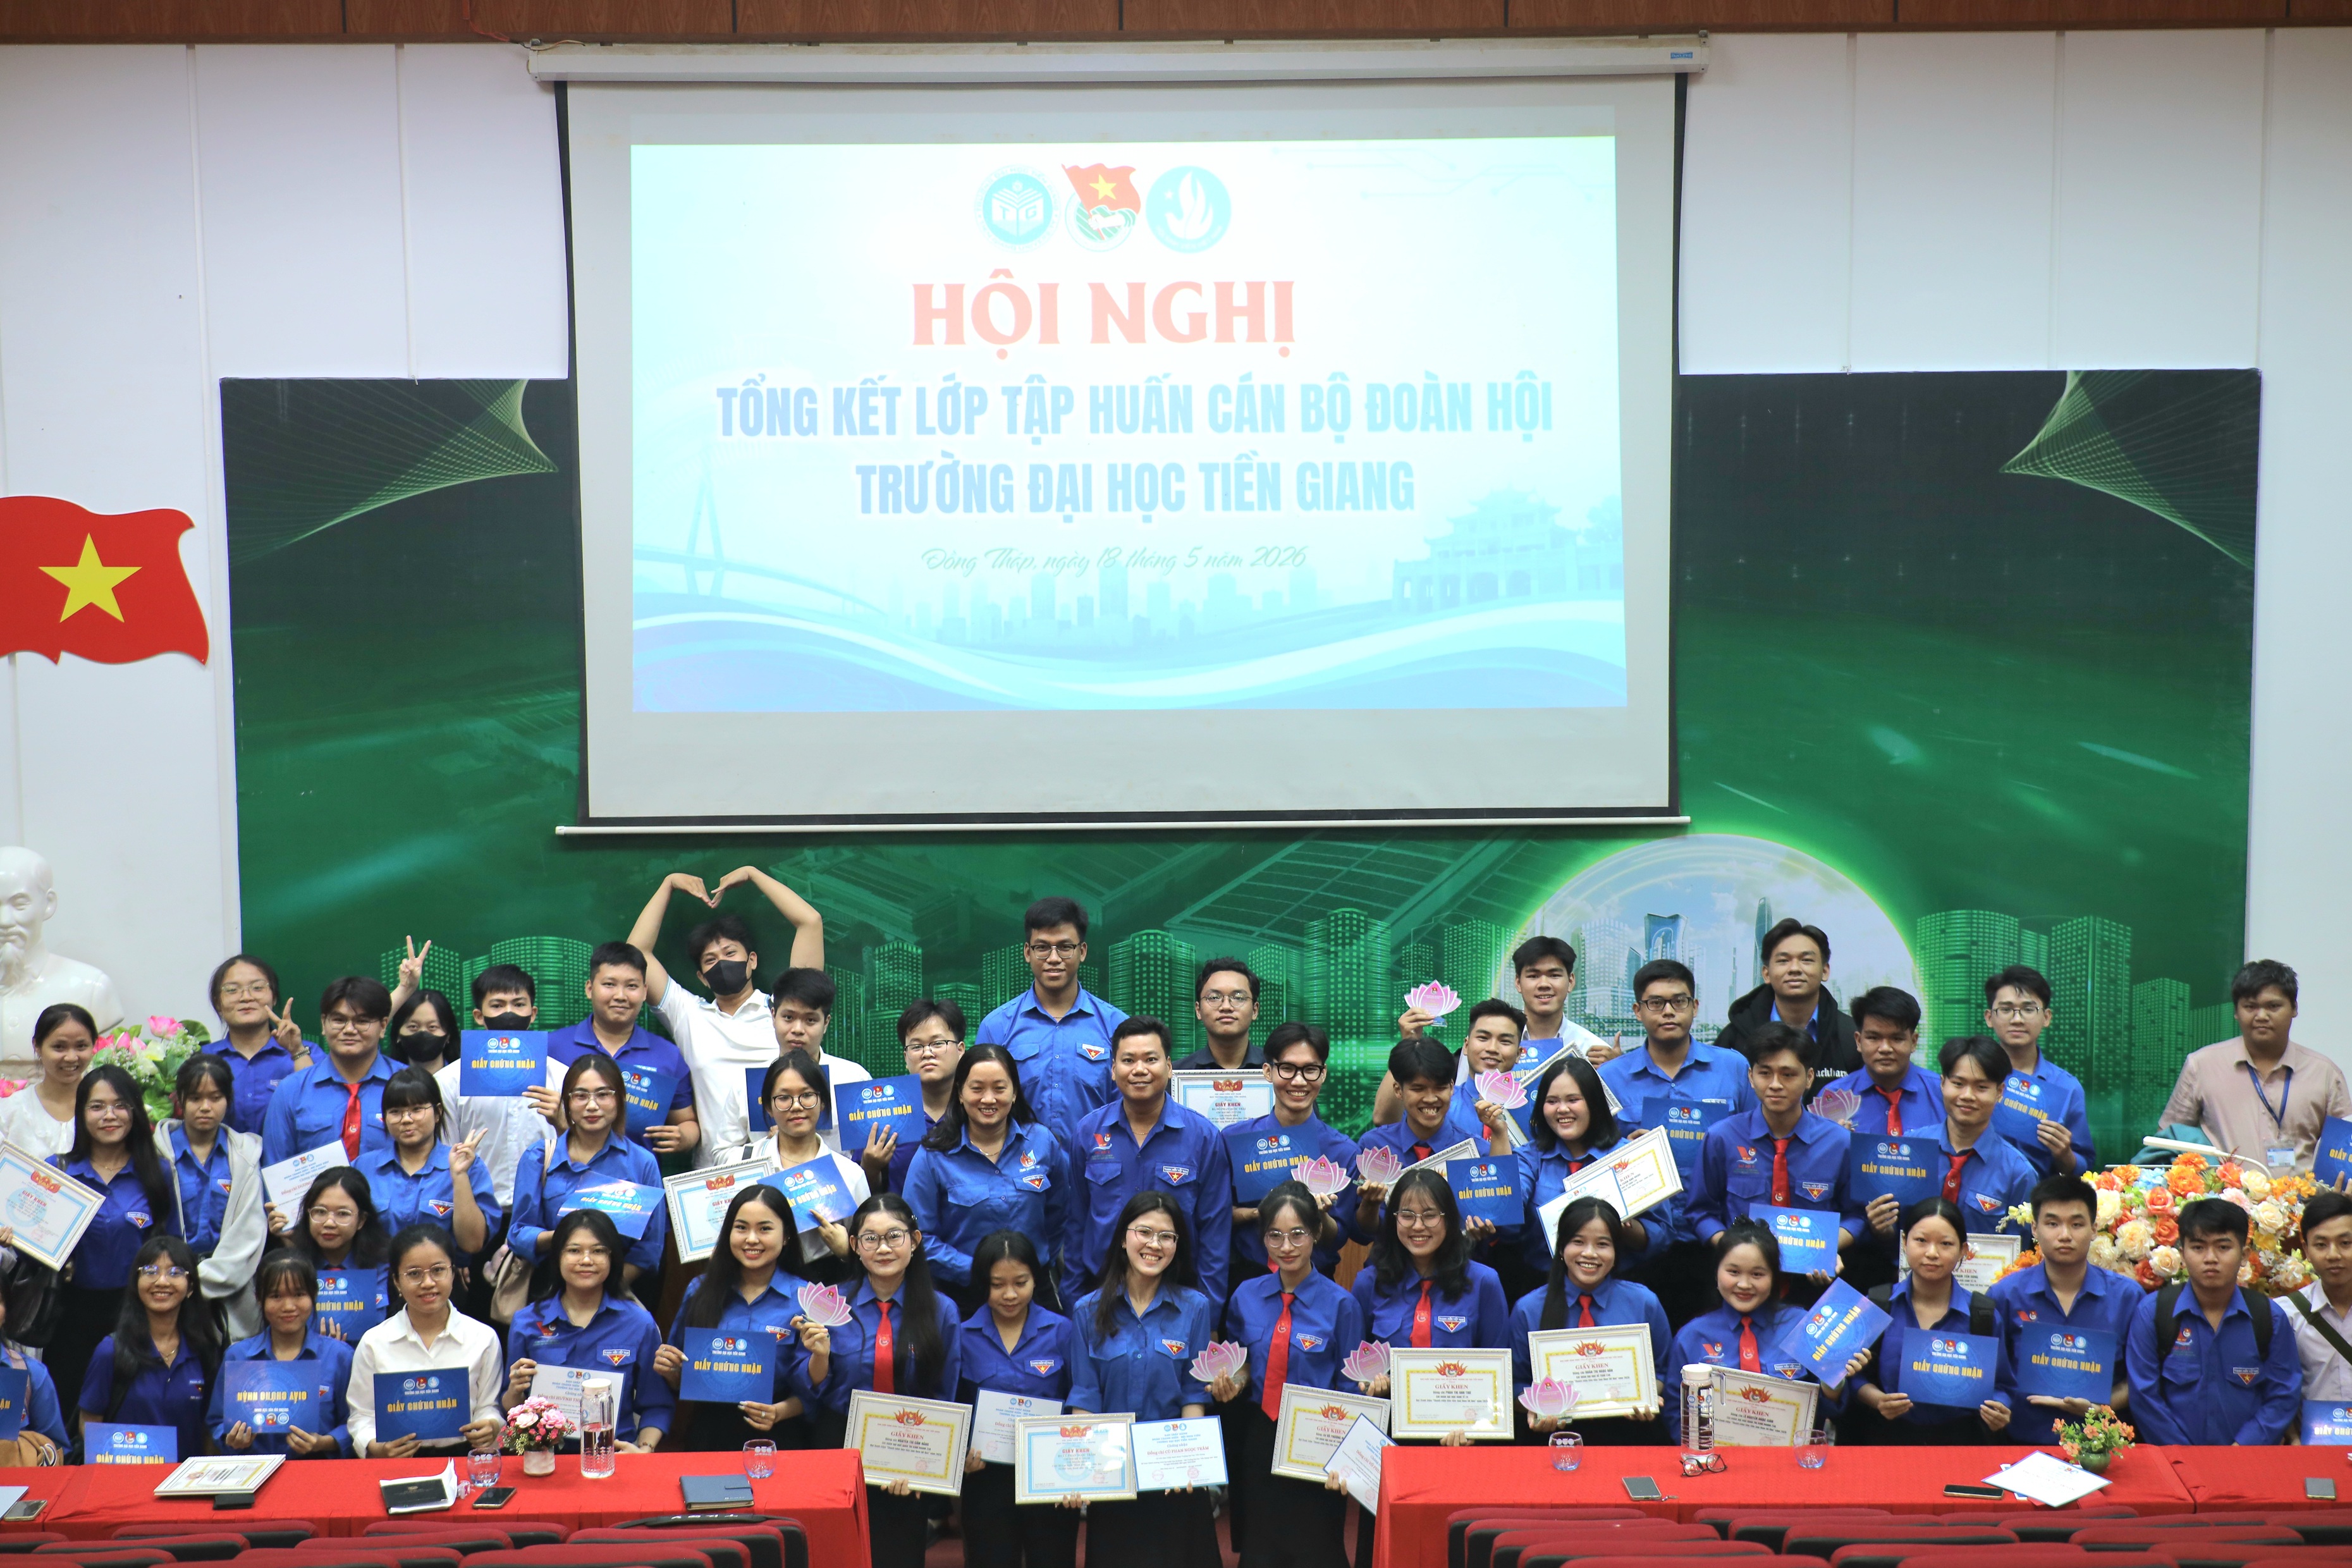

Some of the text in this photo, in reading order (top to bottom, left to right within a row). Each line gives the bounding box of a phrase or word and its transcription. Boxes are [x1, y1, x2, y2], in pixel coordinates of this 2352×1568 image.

[912, 268, 1295, 360] HỘI NGHỊ
[716, 370, 1552, 445] TỔNG KẾT LỚP TẬP HUẤN CÁN BỘ ĐOÀN HỘI
[856, 450, 1414, 523] TRƯỜNG ĐẠI HỌC TIỀN GIANG
[922, 546, 1309, 577] Đồng Tháp, ngày 18 tháng 5 năm 2026
[472, 1057, 536, 1070] GIẤY CHỨNG NHẬN
[848, 1104, 912, 1121] GIẤY CHỨNG NHẬN
[2004, 1098, 2047, 1120] CHỨNG NHẬN
[2329, 1148, 2347, 1161] GIẤY
[1244, 1161, 1260, 1173] GIẤY
[1263, 1158, 1287, 1169] CHỨNG
[1861, 1161, 1926, 1178] GIẤY CHỨNG NHẬN
[1459, 1185, 1512, 1199] GIẤY CHỨNG NHẬN
[316, 1300, 364, 1311] CHỨNG NHẬN
[694, 1358, 762, 1375] GIẤY CHỨNG NHẬN
[1913, 1359, 1982, 1378] GIẤY CHỨNG NHẬN
[2031, 1352, 2101, 1373] GIẤY CHỨNG NHẬN
[388, 1397, 457, 1412] GIẤY CHỨNG NHẬN
[96, 1452, 164, 1464] GIẤY CHỨNG NHẬN
